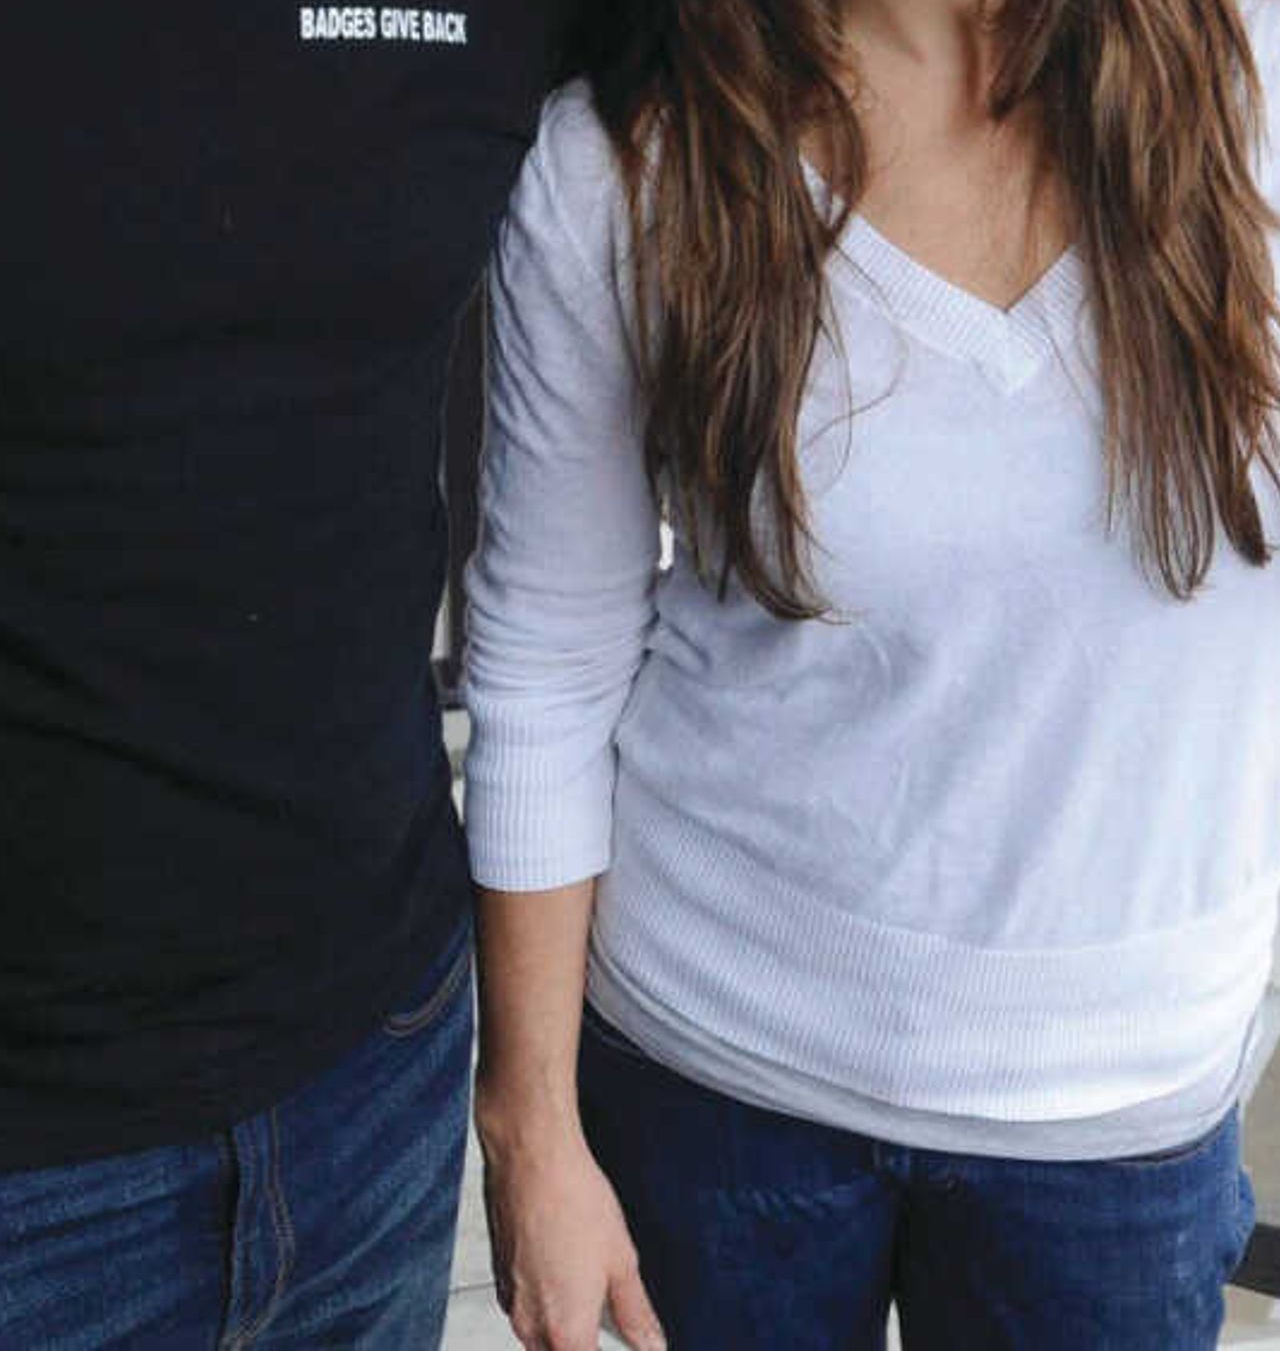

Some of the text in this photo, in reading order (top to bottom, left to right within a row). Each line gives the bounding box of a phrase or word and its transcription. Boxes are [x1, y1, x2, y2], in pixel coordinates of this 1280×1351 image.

[299, 6, 468, 45] BADGES GIVE BACK
